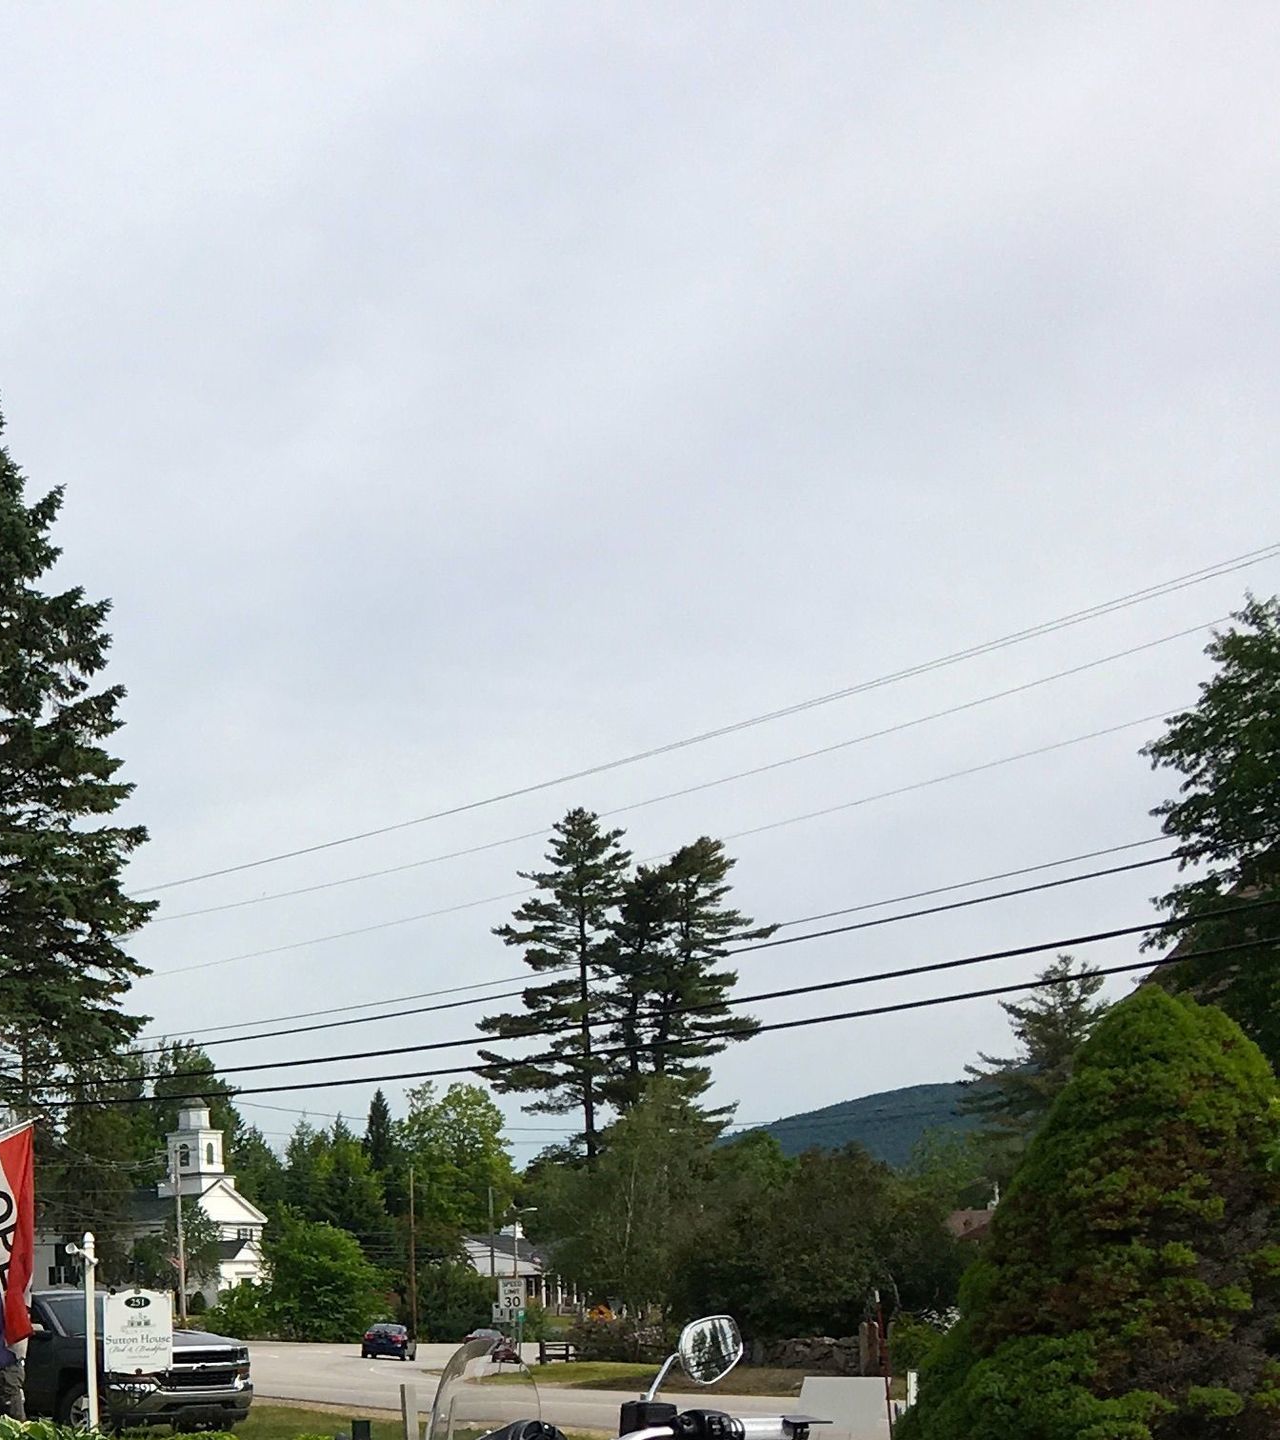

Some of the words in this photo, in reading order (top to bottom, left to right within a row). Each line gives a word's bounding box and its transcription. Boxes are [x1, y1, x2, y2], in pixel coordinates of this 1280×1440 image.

[502, 1279, 523, 1288] SPEED
[130, 1298, 145, 1307] 251
[504, 1296, 521, 1308] 30
[105, 1334, 138, 1345] Sutton
[140, 1333, 171, 1344] House
